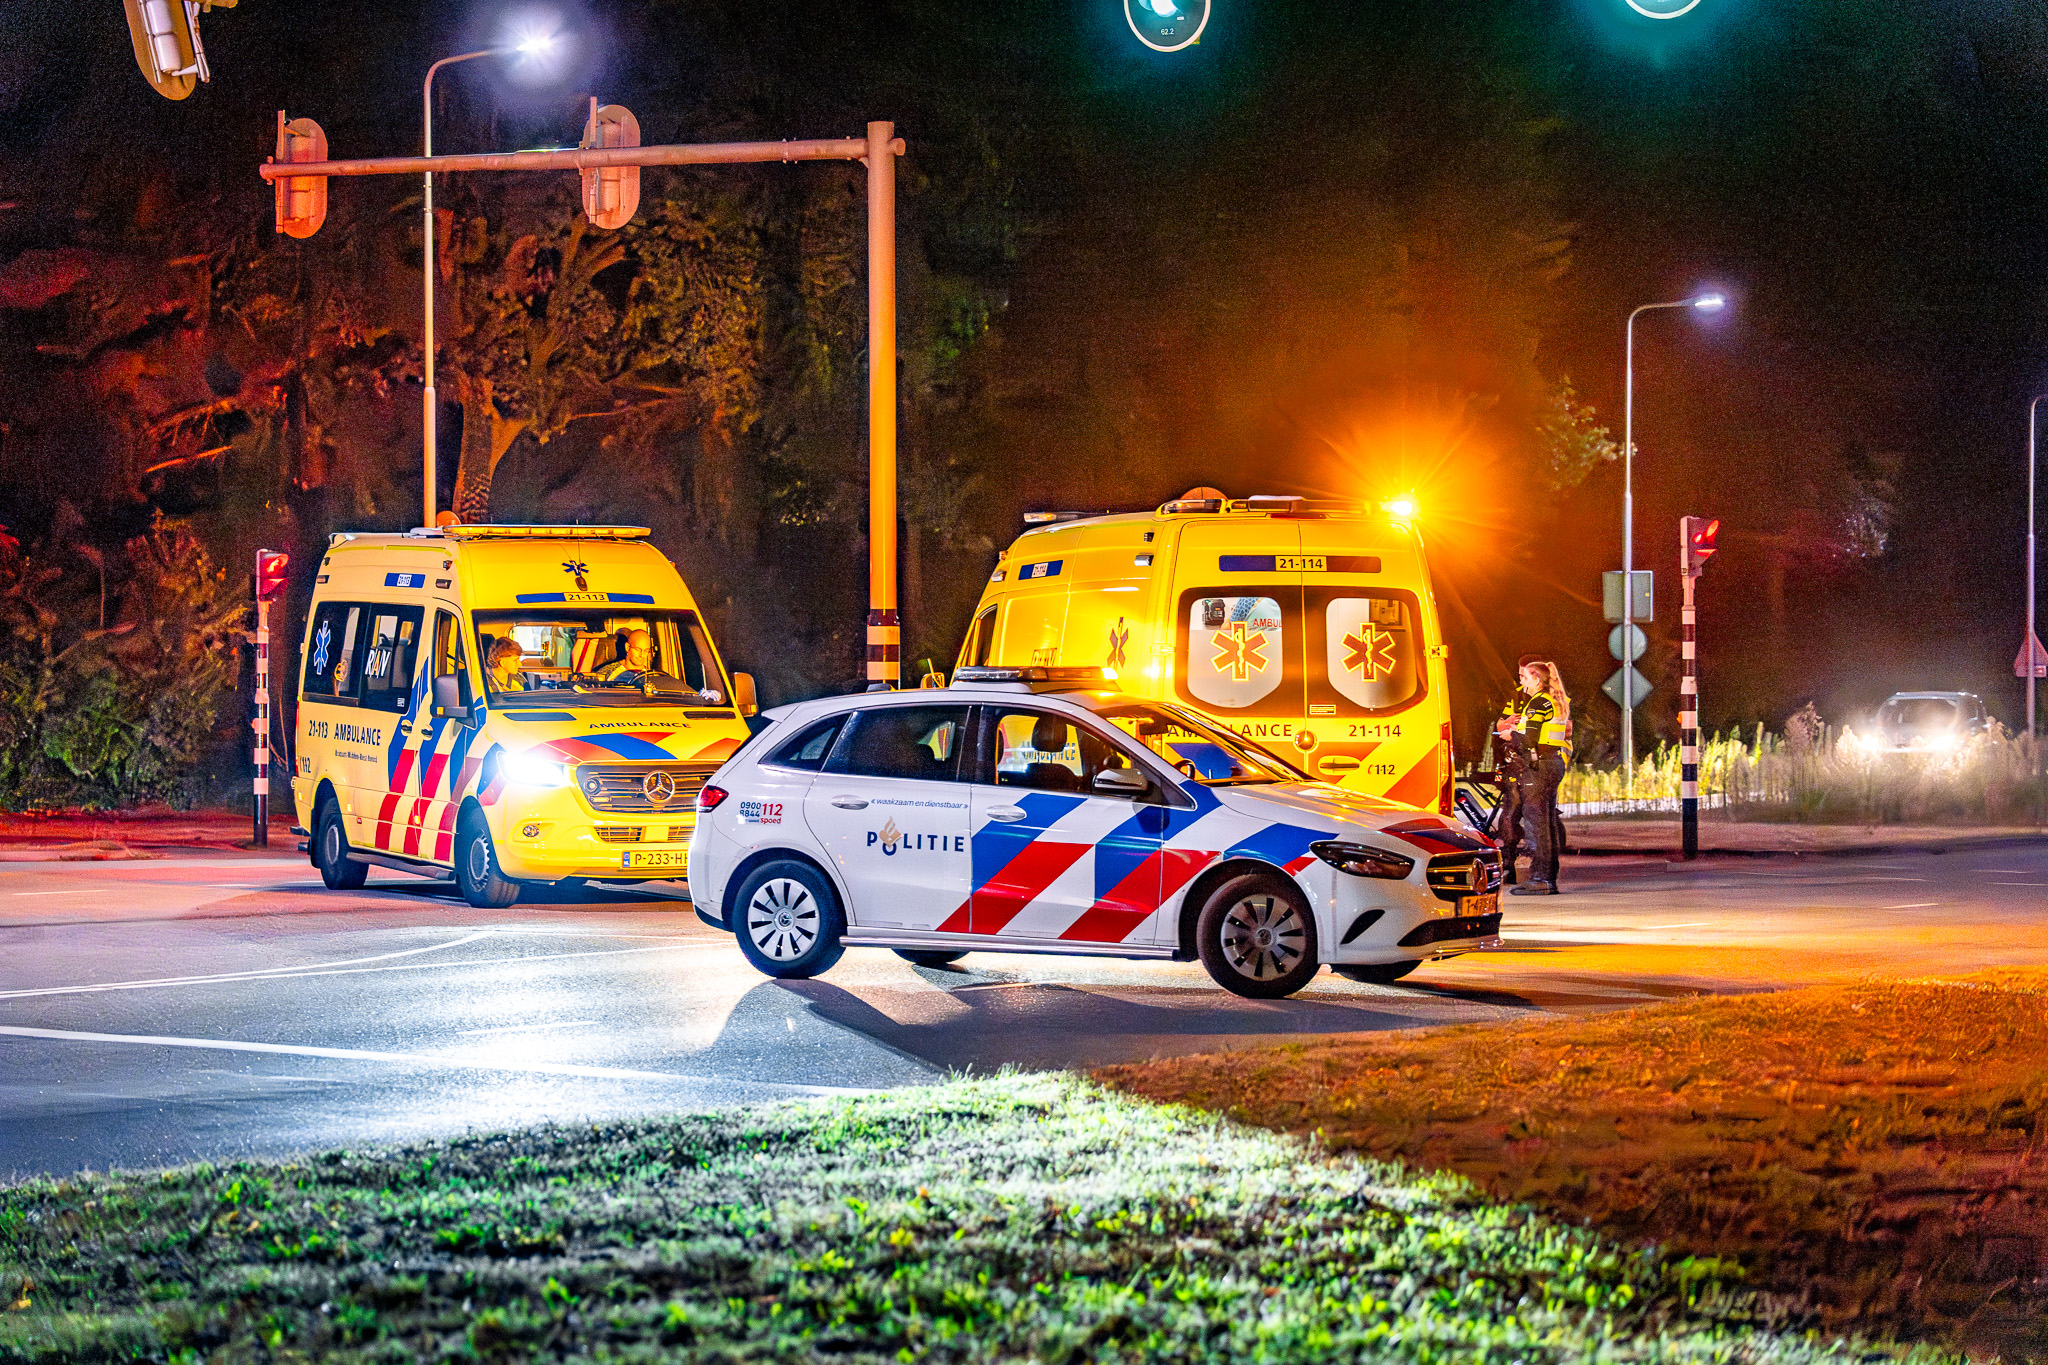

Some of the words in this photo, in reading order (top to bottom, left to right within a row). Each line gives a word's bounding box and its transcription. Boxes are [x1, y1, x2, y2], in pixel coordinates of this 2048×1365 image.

[1279, 558, 1324, 569] 21-114
[589, 721, 692, 729] AMBULANCE
[1348, 724, 1402, 737] 21-114
[308, 719, 329, 739] 21-113
[333, 722, 381, 746] AMBULANCE
[740, 801, 762, 809] 0900
[876, 798, 915, 806] waakzaam
[924, 800, 963, 809] dienstbaar
[762, 803, 783, 816] 112
[760, 816, 782, 825] spoed
[866, 831, 965, 856] POLITIE
